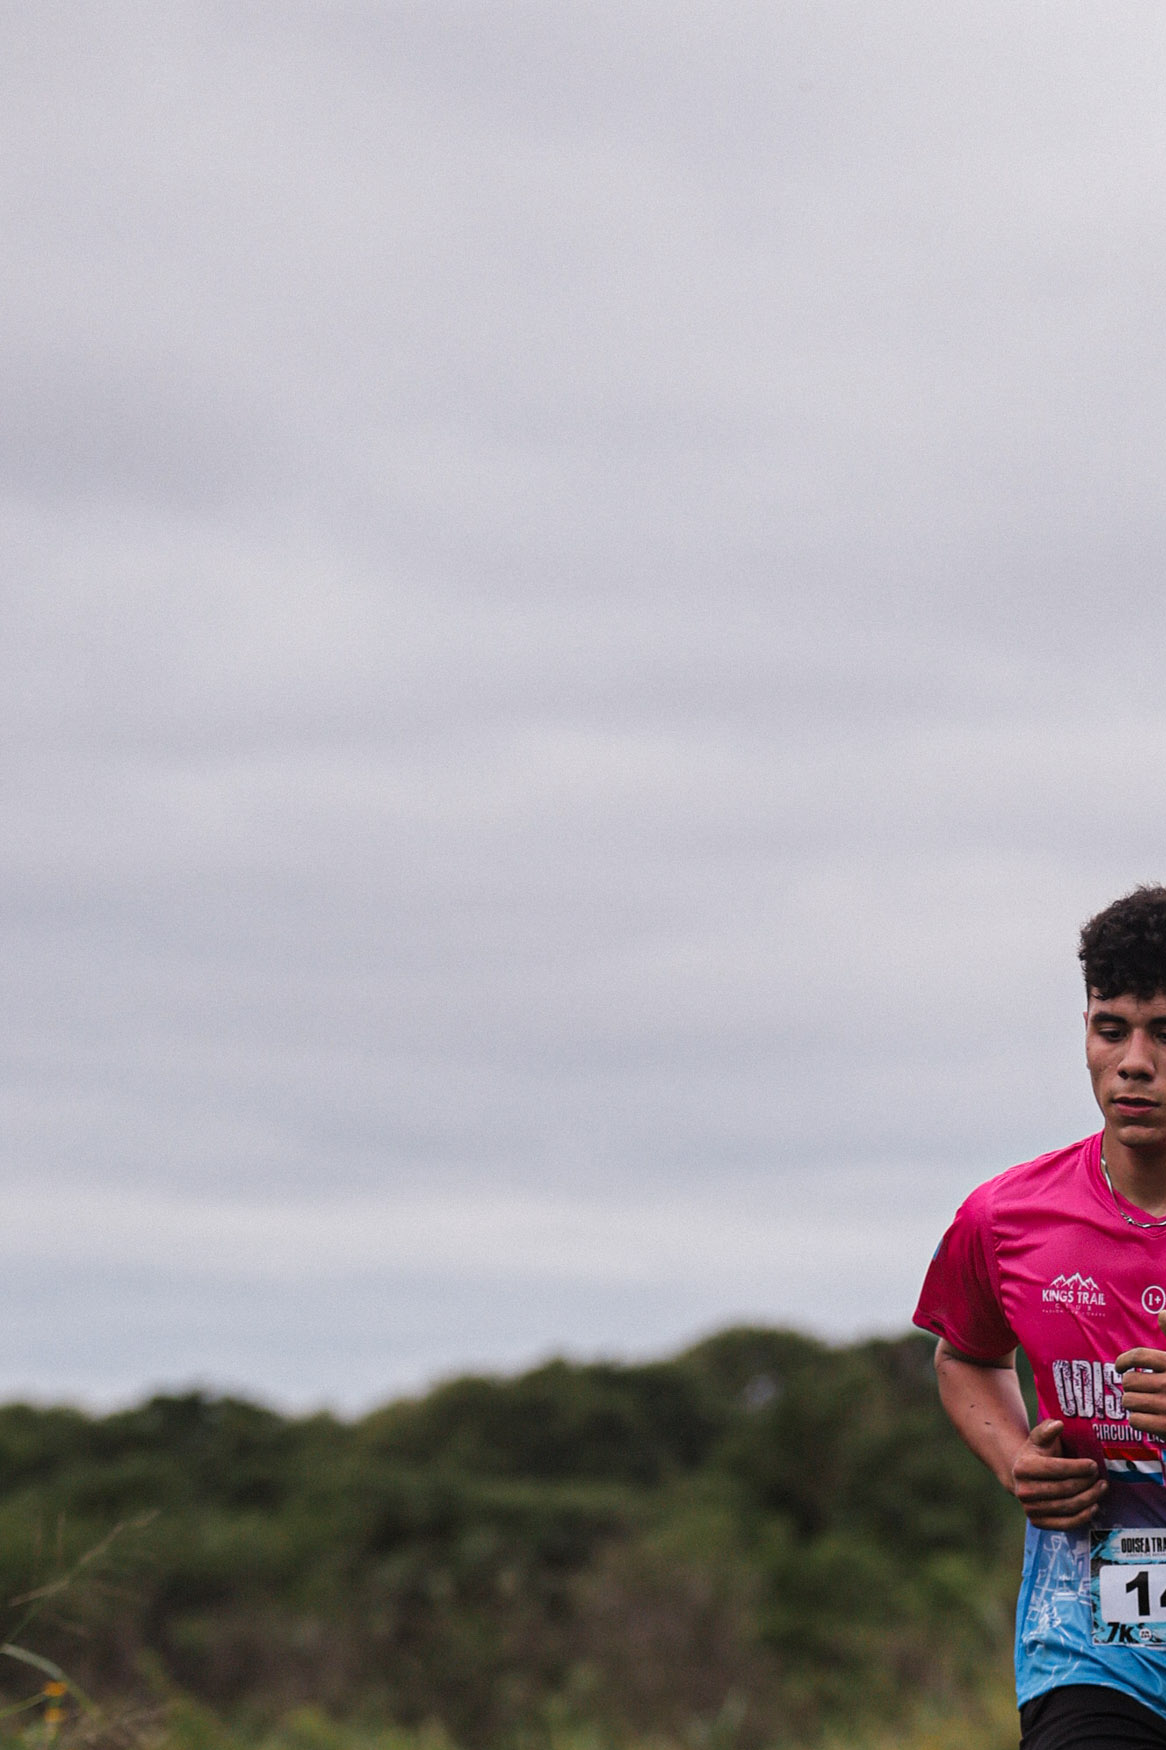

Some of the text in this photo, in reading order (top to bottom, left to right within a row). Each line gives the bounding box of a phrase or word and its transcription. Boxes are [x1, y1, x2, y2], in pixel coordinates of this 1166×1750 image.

[1042, 1289, 1106, 1306] KINGS TRAIL
[1052, 1359, 1153, 1421] ODIS
[1092, 1423, 1143, 1443] CIRCUITO
[1121, 1538, 1151, 1554] ODISEA
[1107, 1622, 1134, 1644] 7K
